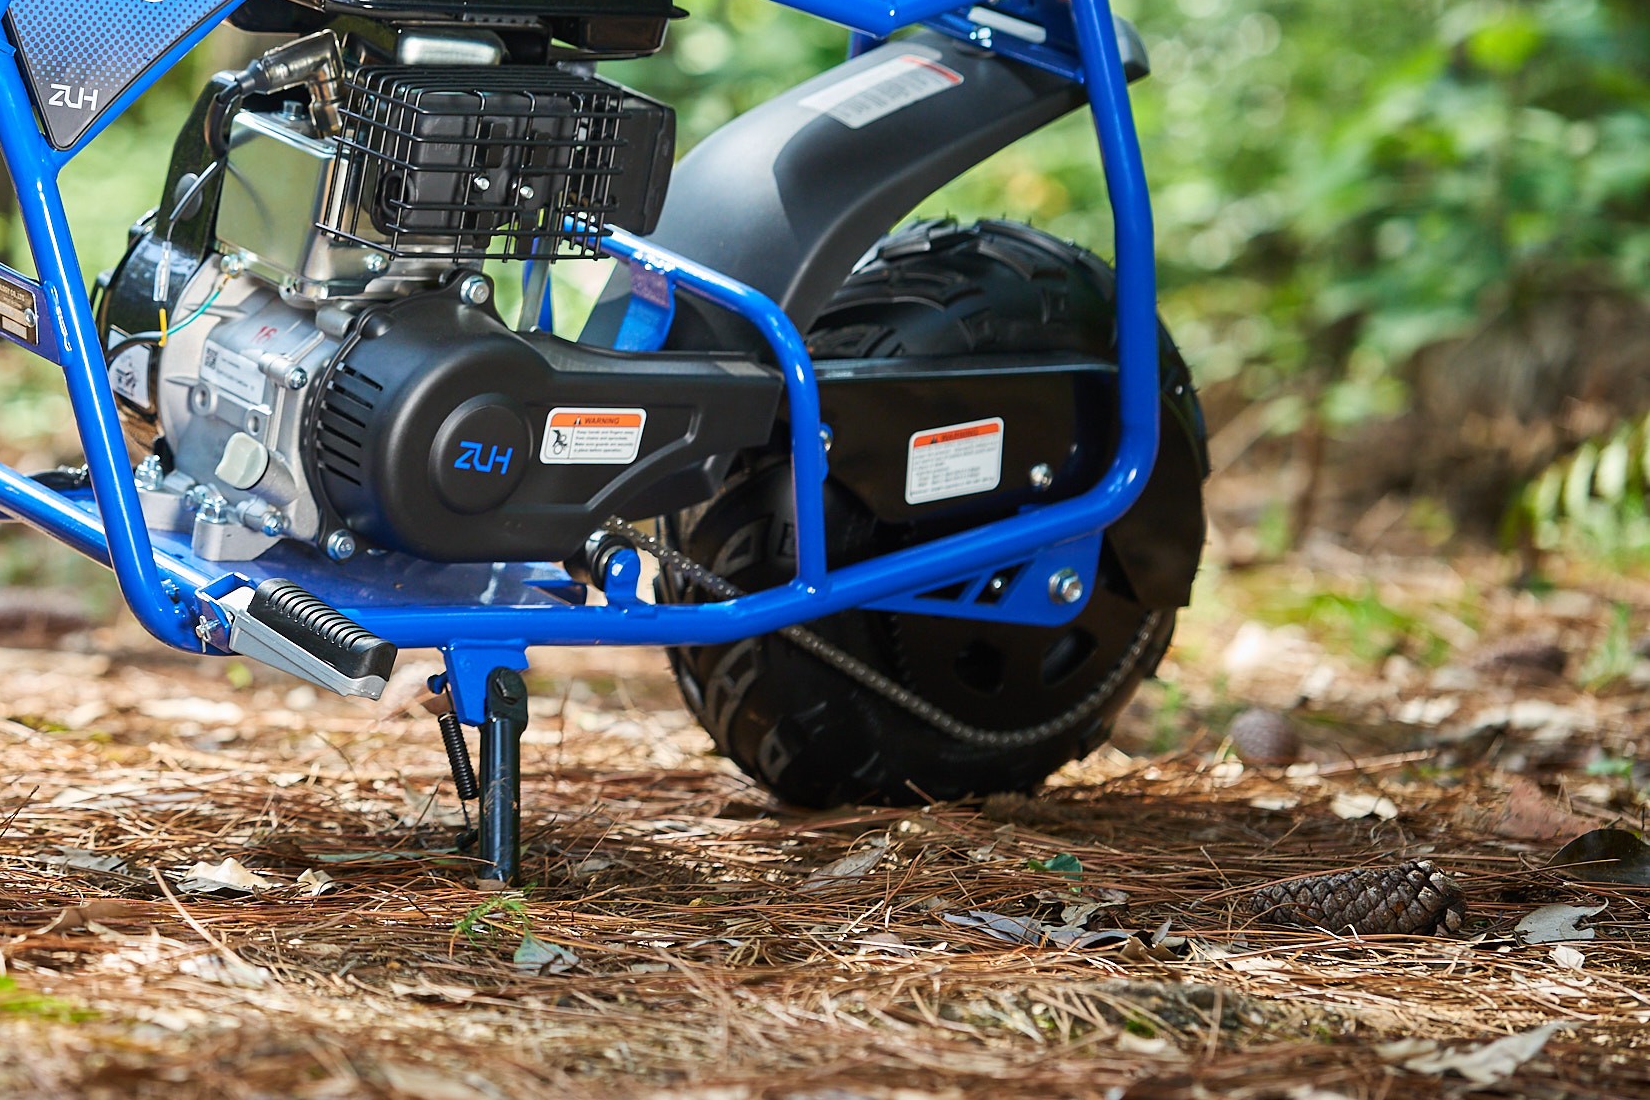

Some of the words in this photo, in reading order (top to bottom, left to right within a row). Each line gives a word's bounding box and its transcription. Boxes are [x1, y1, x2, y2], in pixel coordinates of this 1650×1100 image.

[48, 83, 99, 112] ZUH
[584, 417, 620, 425] WARNING
[453, 440, 514, 475] ZUH
